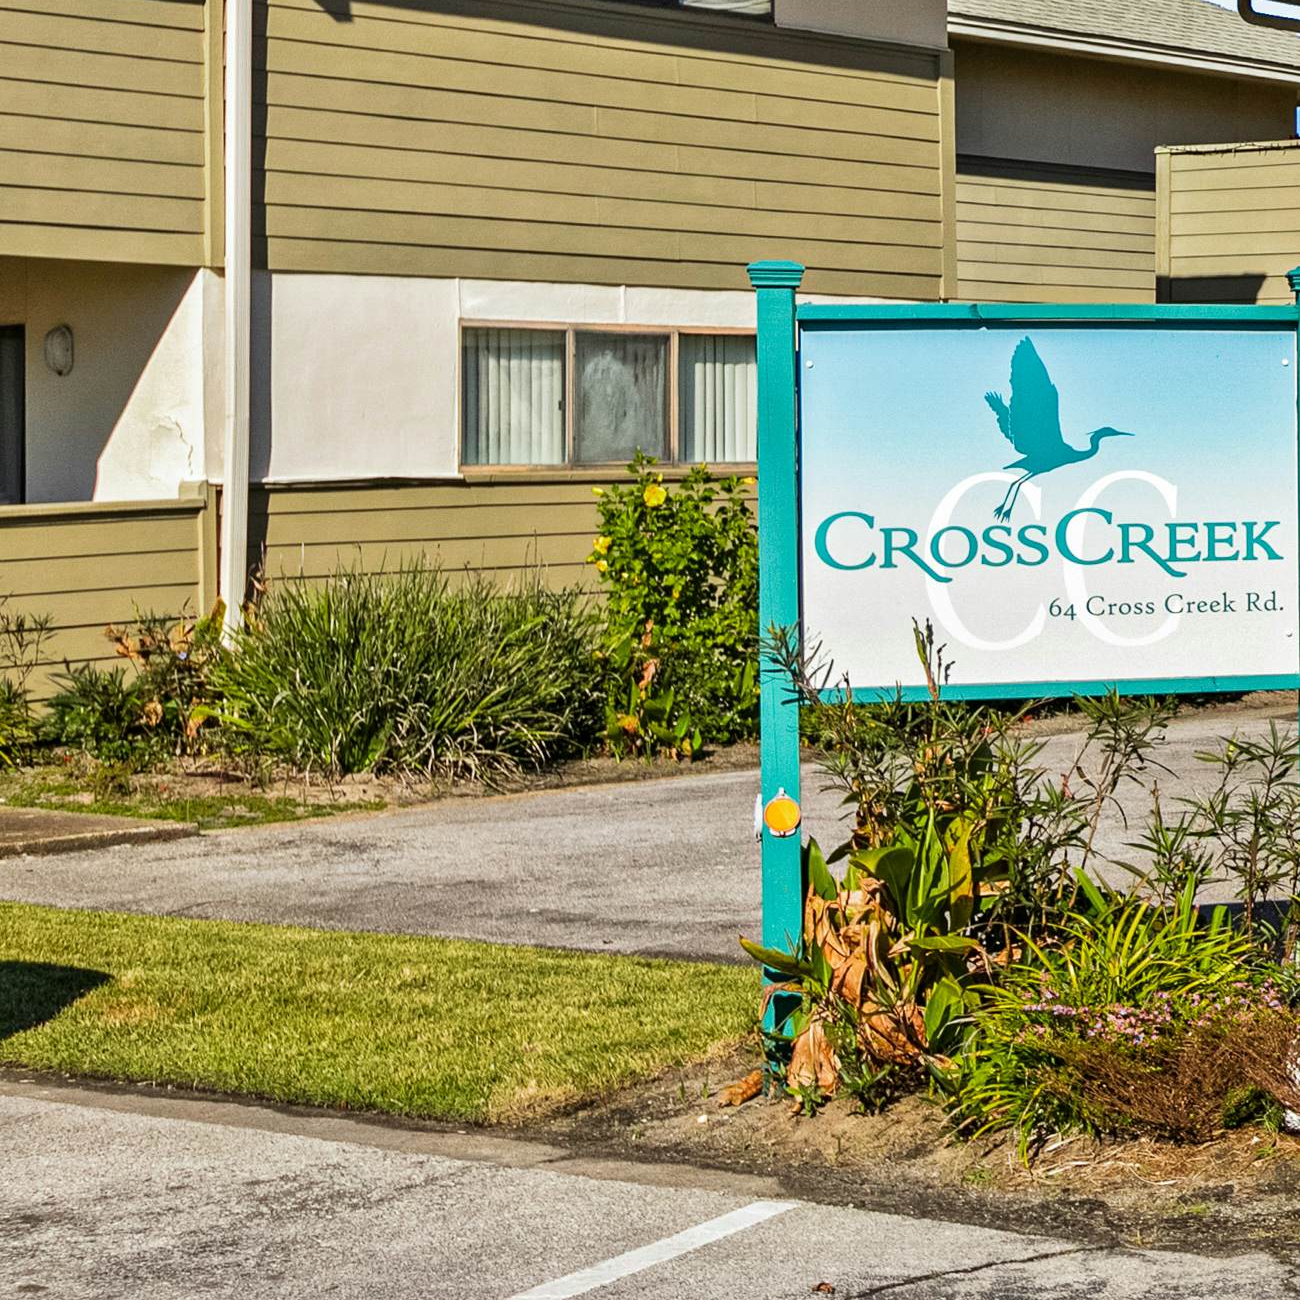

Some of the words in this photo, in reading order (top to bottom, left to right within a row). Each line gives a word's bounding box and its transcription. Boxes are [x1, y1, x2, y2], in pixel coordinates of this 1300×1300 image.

[1049, 597, 1077, 620] 64
[1086, 595, 1155, 616] Cross
[1164, 592, 1237, 614] Creek
[1246, 591, 1284, 612] Rd.
